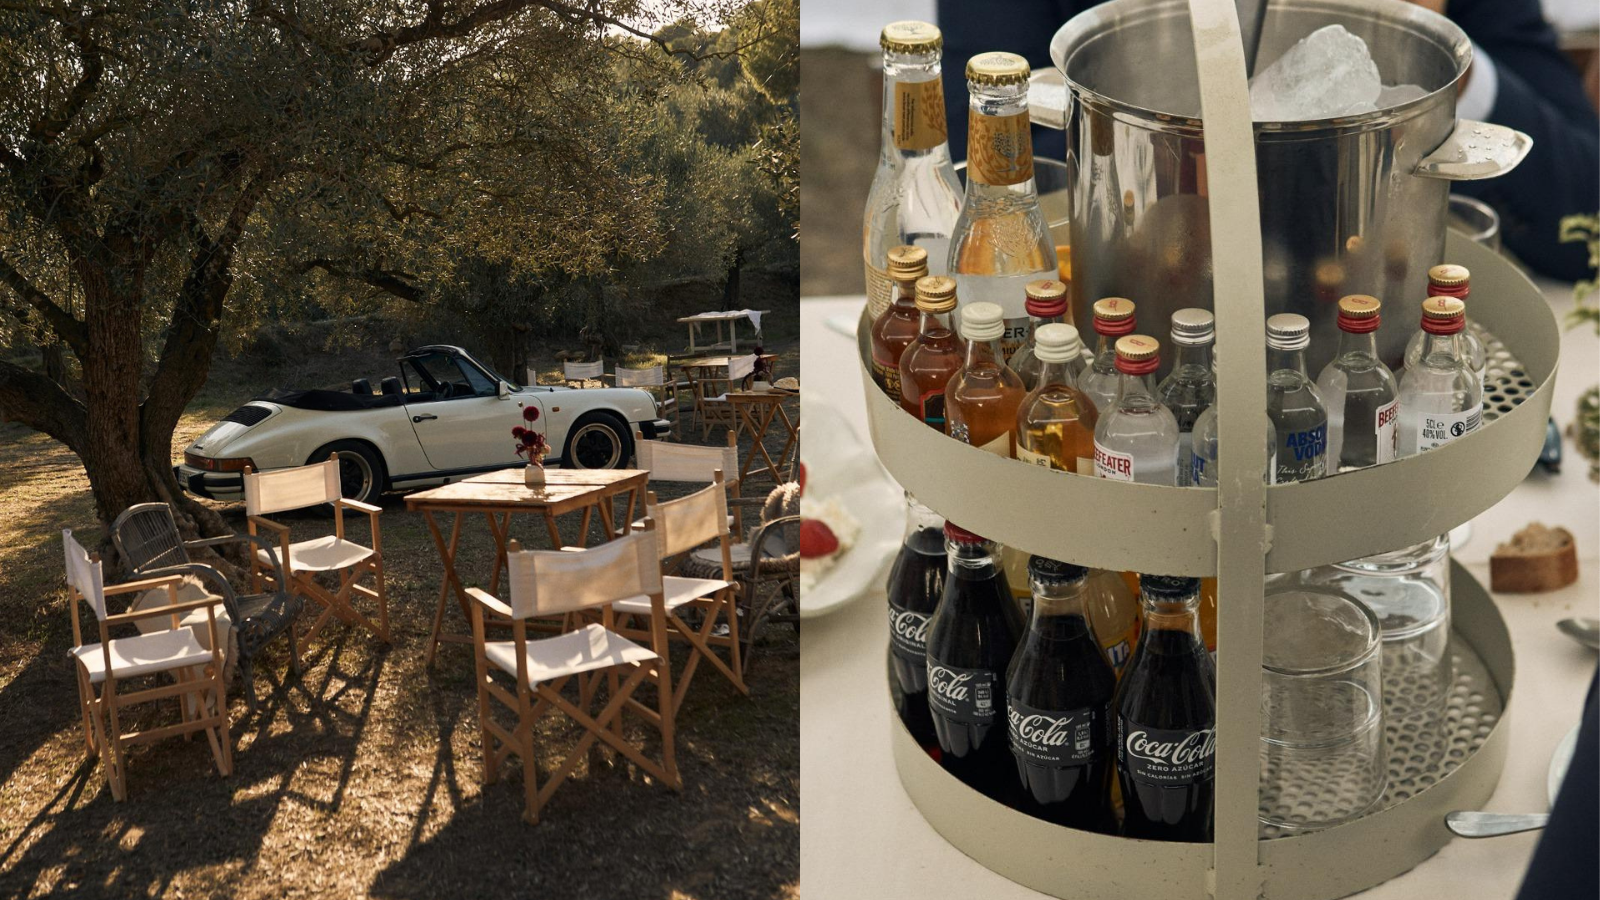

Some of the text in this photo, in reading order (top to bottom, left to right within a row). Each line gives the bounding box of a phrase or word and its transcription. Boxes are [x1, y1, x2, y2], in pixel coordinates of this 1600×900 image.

[1426, 418, 1436, 429] 5CL
[1422, 428, 1448, 440] 40% VOL.
[1146, 763, 1169, 772] ZERO
